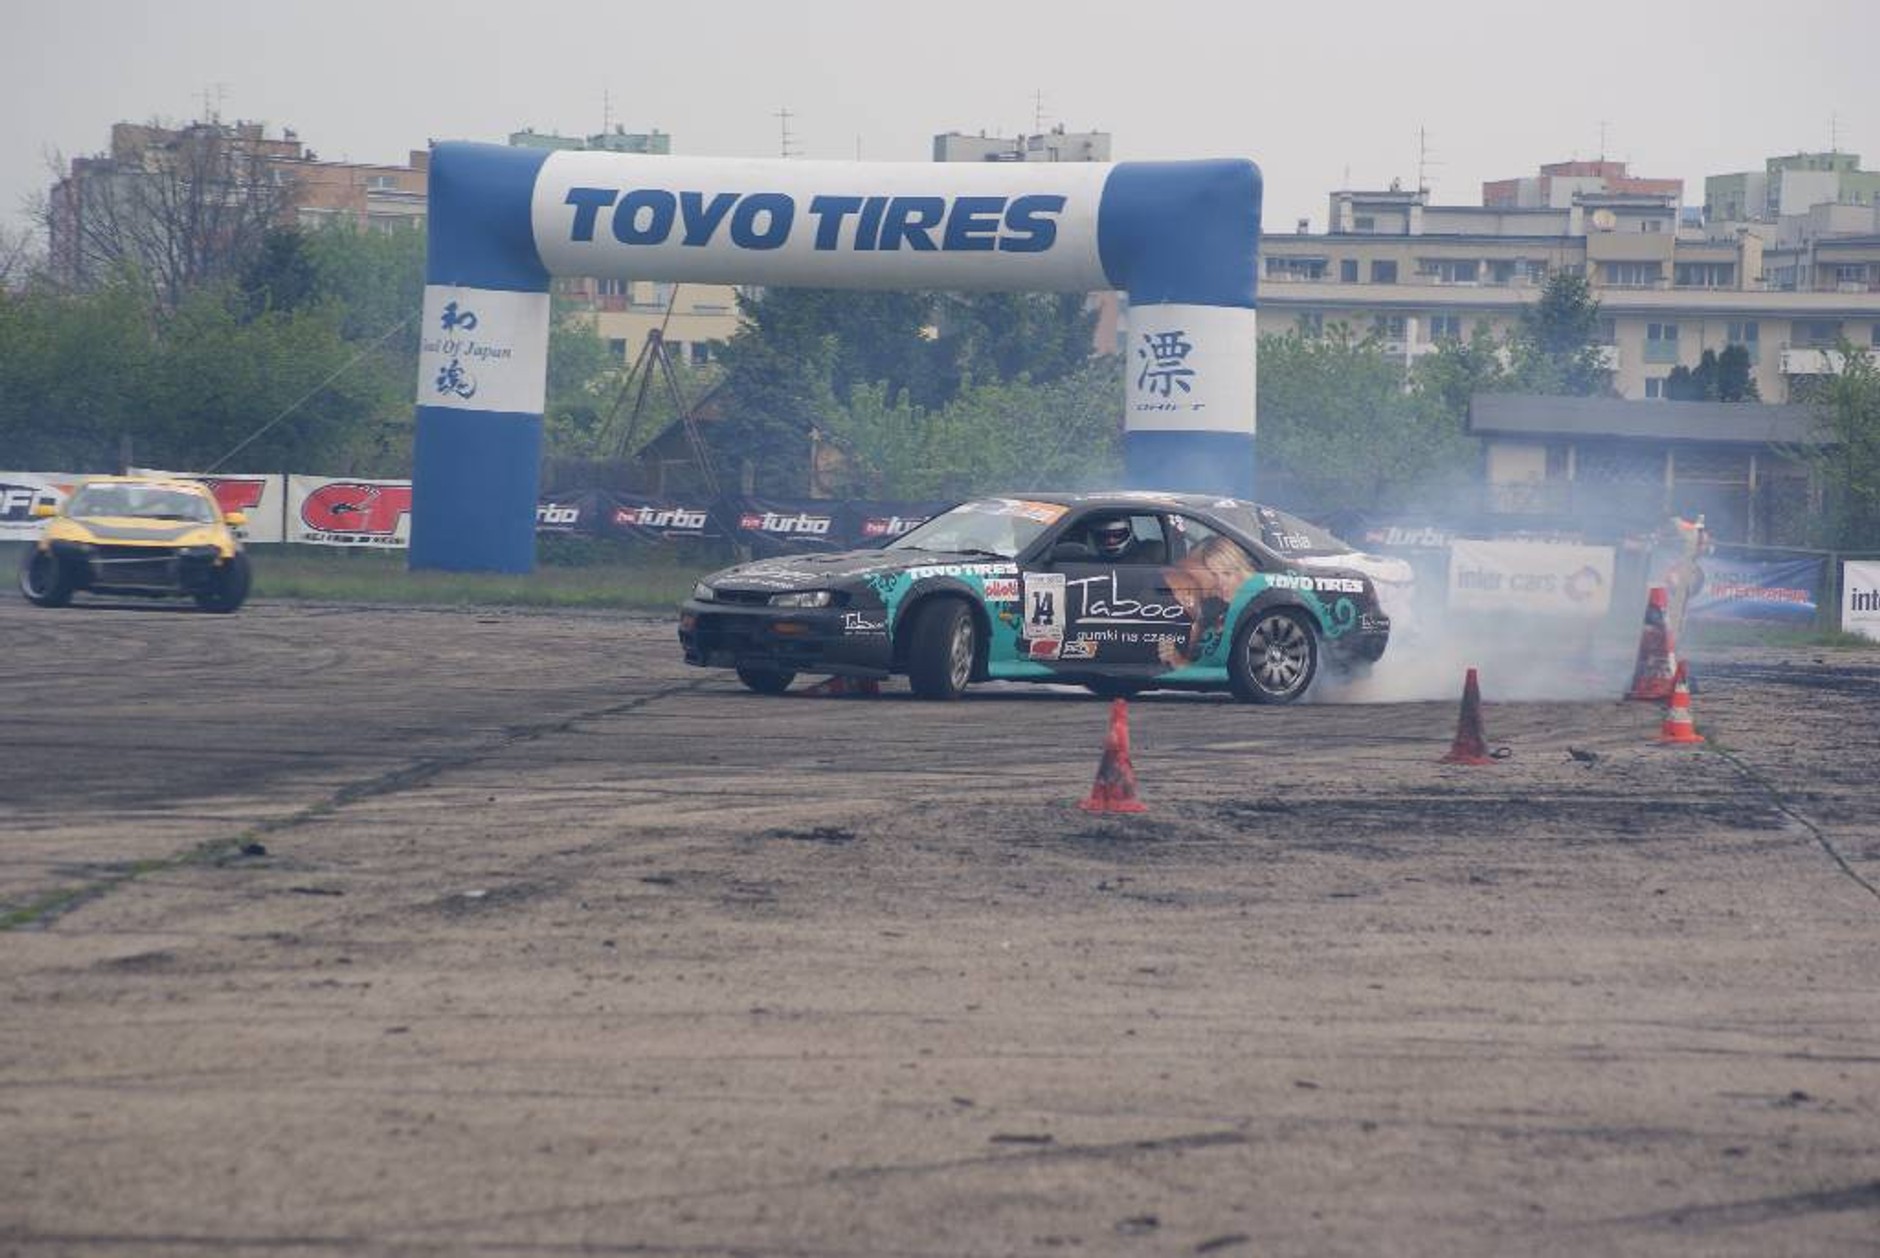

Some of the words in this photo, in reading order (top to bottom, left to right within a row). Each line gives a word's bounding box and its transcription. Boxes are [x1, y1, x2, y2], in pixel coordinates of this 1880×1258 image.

[564, 187, 795, 250] TOYO
[808, 194, 1068, 252] TIRES
[463, 341, 513, 360] Japan
[1138, 330, 1195, 397] 漂
[636, 506, 707, 528] turbo
[761, 511, 832, 534] turbo
[906, 565, 961, 579] TOYO
[962, 562, 1019, 577] TIRES
[1066, 569, 1184, 618] Taboo
[1264, 573, 1313, 590] TOYO
[1314, 577, 1364, 593] TIRES
[1032, 591, 1054, 625] 14
[1851, 588, 1880, 611] int
